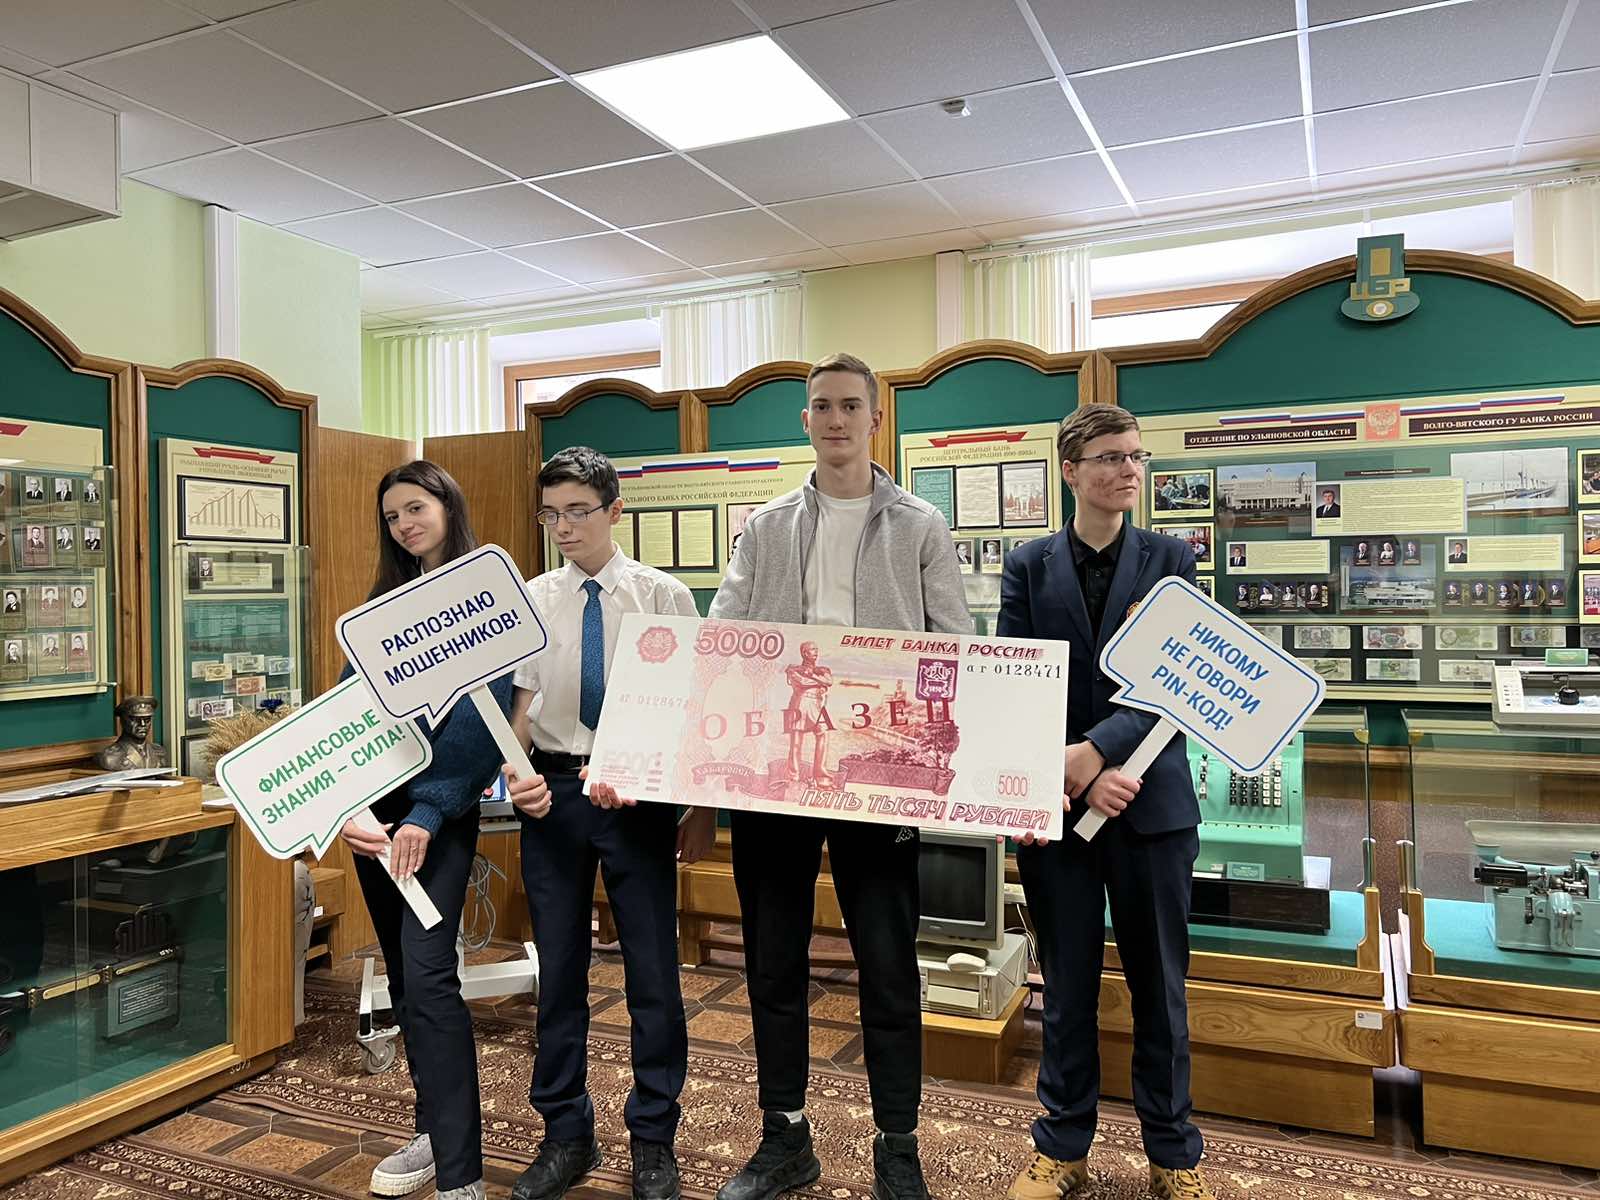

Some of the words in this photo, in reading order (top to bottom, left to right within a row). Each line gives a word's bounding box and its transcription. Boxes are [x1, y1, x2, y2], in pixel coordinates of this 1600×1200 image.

[1189, 435, 1237, 444] ОТДЕЛЕНИЕ
[1238, 434, 1249, 442] ПО
[1250, 429, 1310, 441] УЛЬЯНОВСКОЙ
[1311, 428, 1351, 437] ОБЛАСТИ
[1423, 417, 1504, 430] ВОЛГО-ВЯТСКОГО
[1505, 416, 1518, 425] ГУ
[1519, 414, 1551, 424] БАНКА
[1553, 412, 1593, 422] РОССИИ
[680, 489, 728, 500] РОССИЙСКОЙ
[729, 488, 774, 498] ФЕДЕРАЦИИ
[380, 590, 496, 656] РАСПОЗНАЮ
[695, 624, 785, 660] 5000
[383, 608, 522, 686] МОШЕННИКОВ!
[840, 634, 896, 649] БИЛЕТ
[901, 638, 960, 656] БАНКА
[966, 643, 1043, 660] РОССИИ
[1188, 621, 1270, 682] НИКОМУ
[994, 663, 1062, 679] 0128471
[1160, 636, 1191, 663] НЕ
[1186, 654, 1261, 714] ГОВОРИ
[1151, 664, 1234, 731] PIN-КОД!
[257, 709, 381, 794] ФИНАНСОВЫЕ
[261, 773, 337, 825] ЗНАНИЯ
[352, 725, 407, 768] СИЛА!
[997, 774, 1029, 797] 5000
[799, 789, 862, 811] ПЯТЬ
[867, 793, 949, 820] ТЫСЯЧ
[949, 802, 1052, 831] РУБЛЕЙ
